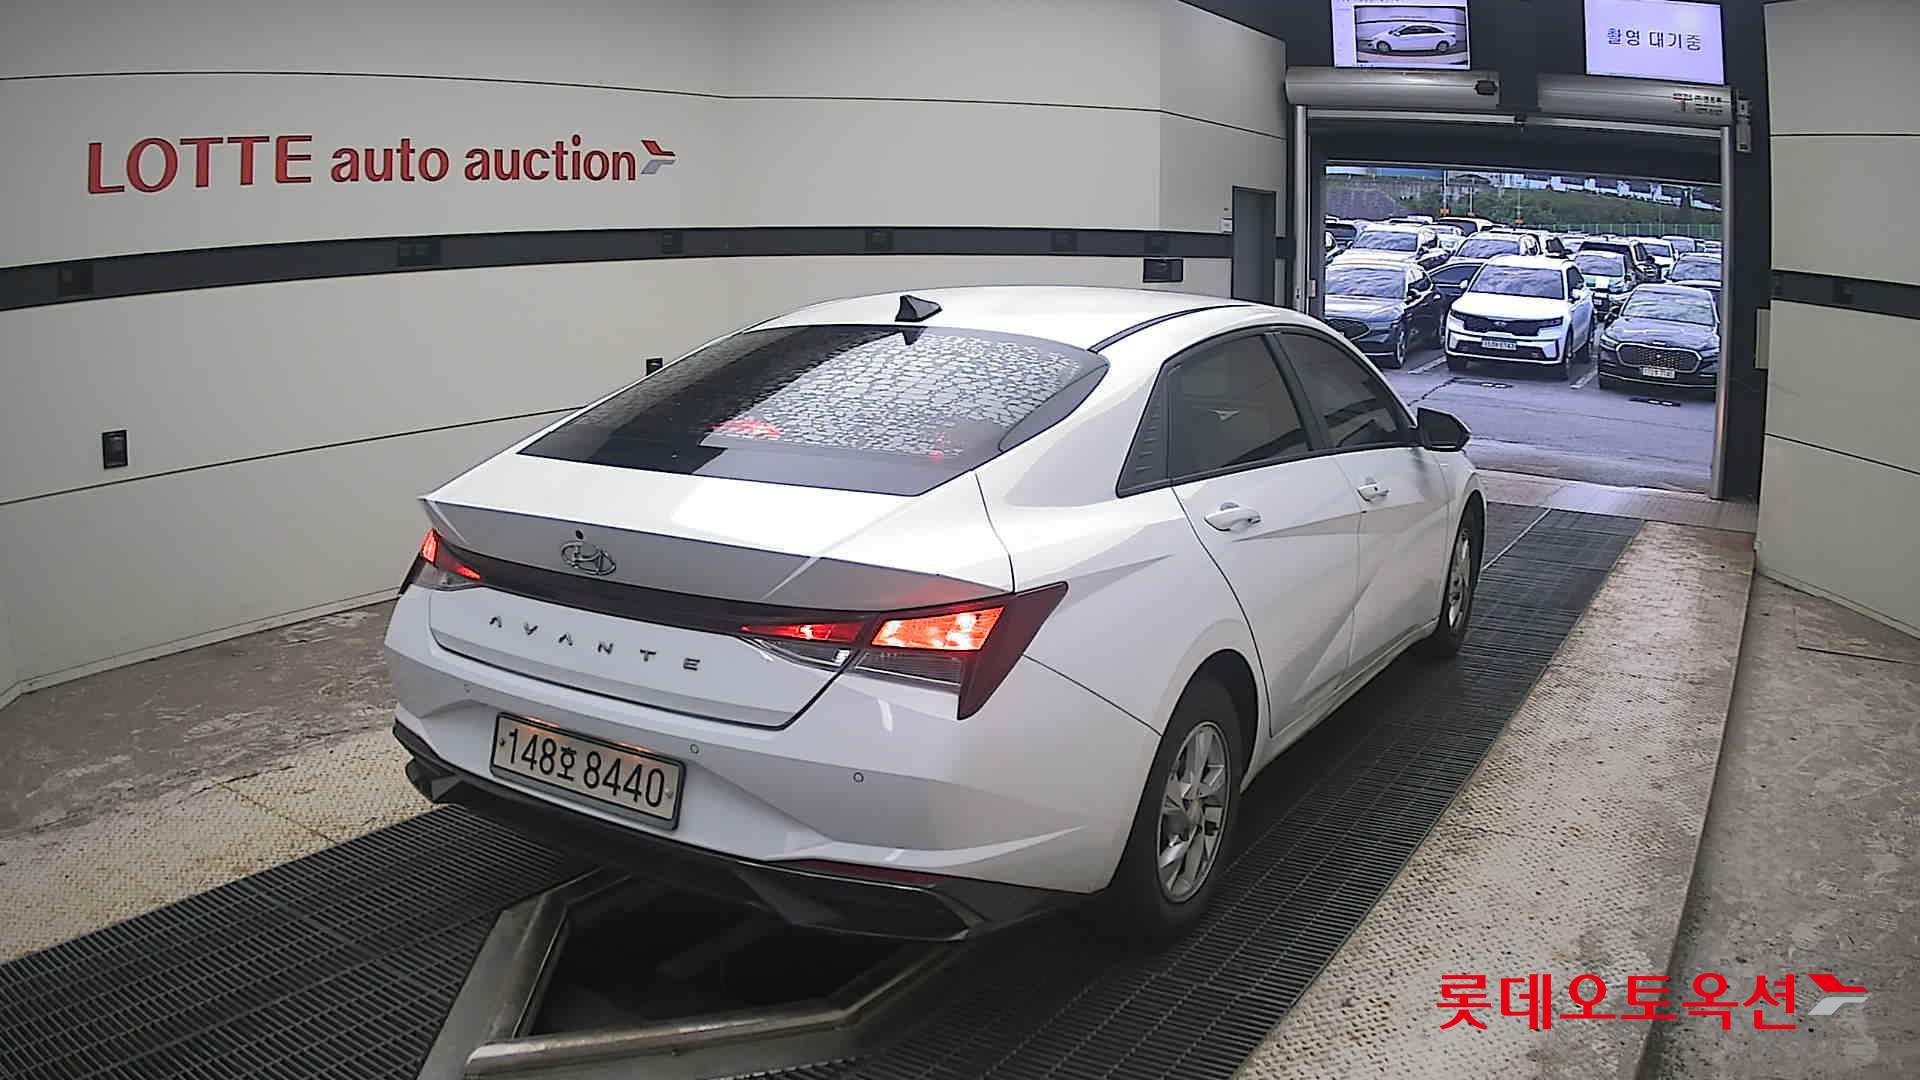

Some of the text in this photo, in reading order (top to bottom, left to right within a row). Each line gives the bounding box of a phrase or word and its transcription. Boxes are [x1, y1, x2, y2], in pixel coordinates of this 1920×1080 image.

[88, 134, 636, 194] LOTTE auto auction
[489, 616, 701, 671] AVANTE
[584, 751, 665, 807] 8440
